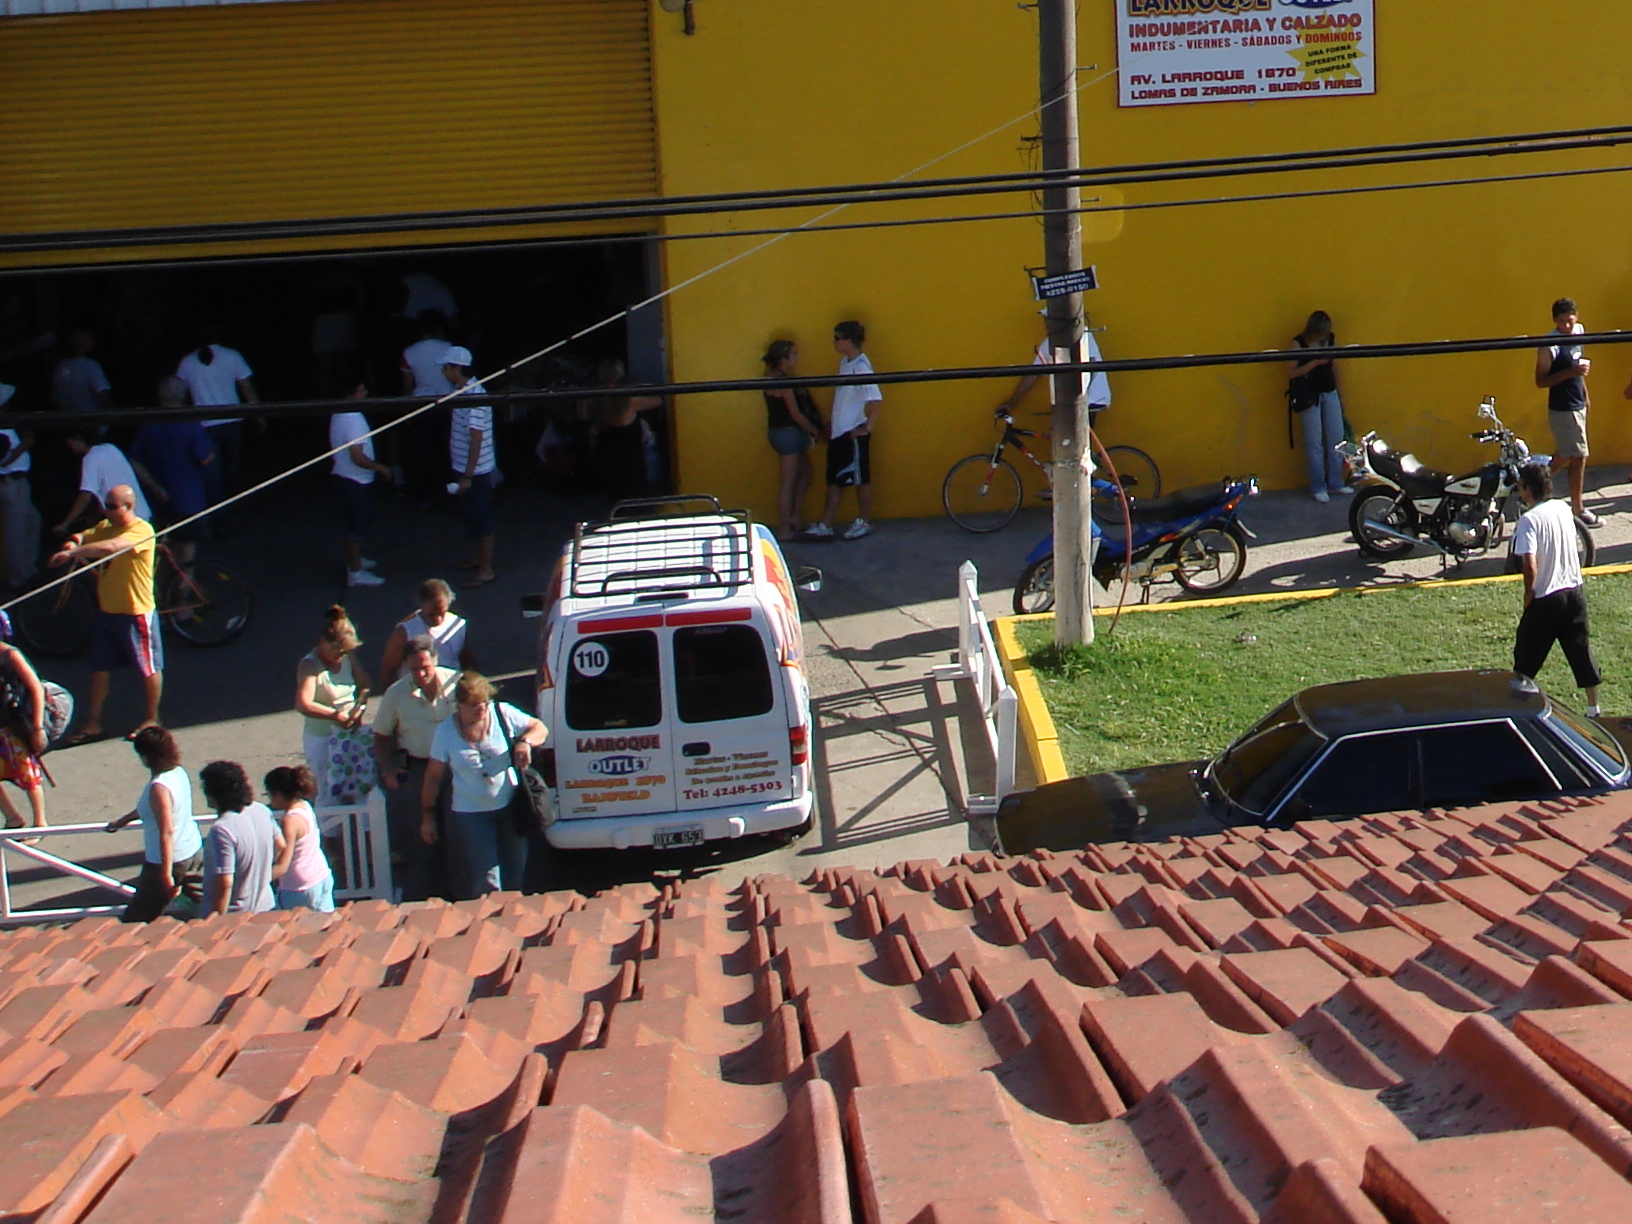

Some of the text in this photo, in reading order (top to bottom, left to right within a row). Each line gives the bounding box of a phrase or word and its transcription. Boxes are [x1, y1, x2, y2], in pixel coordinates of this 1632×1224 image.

[1129, 13, 1362, 38] INDUMENTARIA Y CALZADO
[1130, 40, 1176, 52] MARTES
[1186, 37, 1231, 50] VIERNES
[1241, 34, 1292, 47] SÁBADOS
[1295, 34, 1302, 44] Y
[1305, 31, 1362, 44] DOMINGOS
[1130, 67, 1296, 85] AV. LARROQUE 1870
[1131, 88, 1176, 100] LOMAS
[1180, 87, 1198, 97] DE
[1202, 83, 1256, 96] ZAMORA
[1268, 80, 1320, 93] BUENOS
[1324, 79, 1362, 90] AIRES
[576, 649, 605, 669] 110
[576, 734, 661, 753] LARROQUE
[588, 757, 651, 774] OUTLET
[683, 780, 783, 800] Tel: 4248-5303
